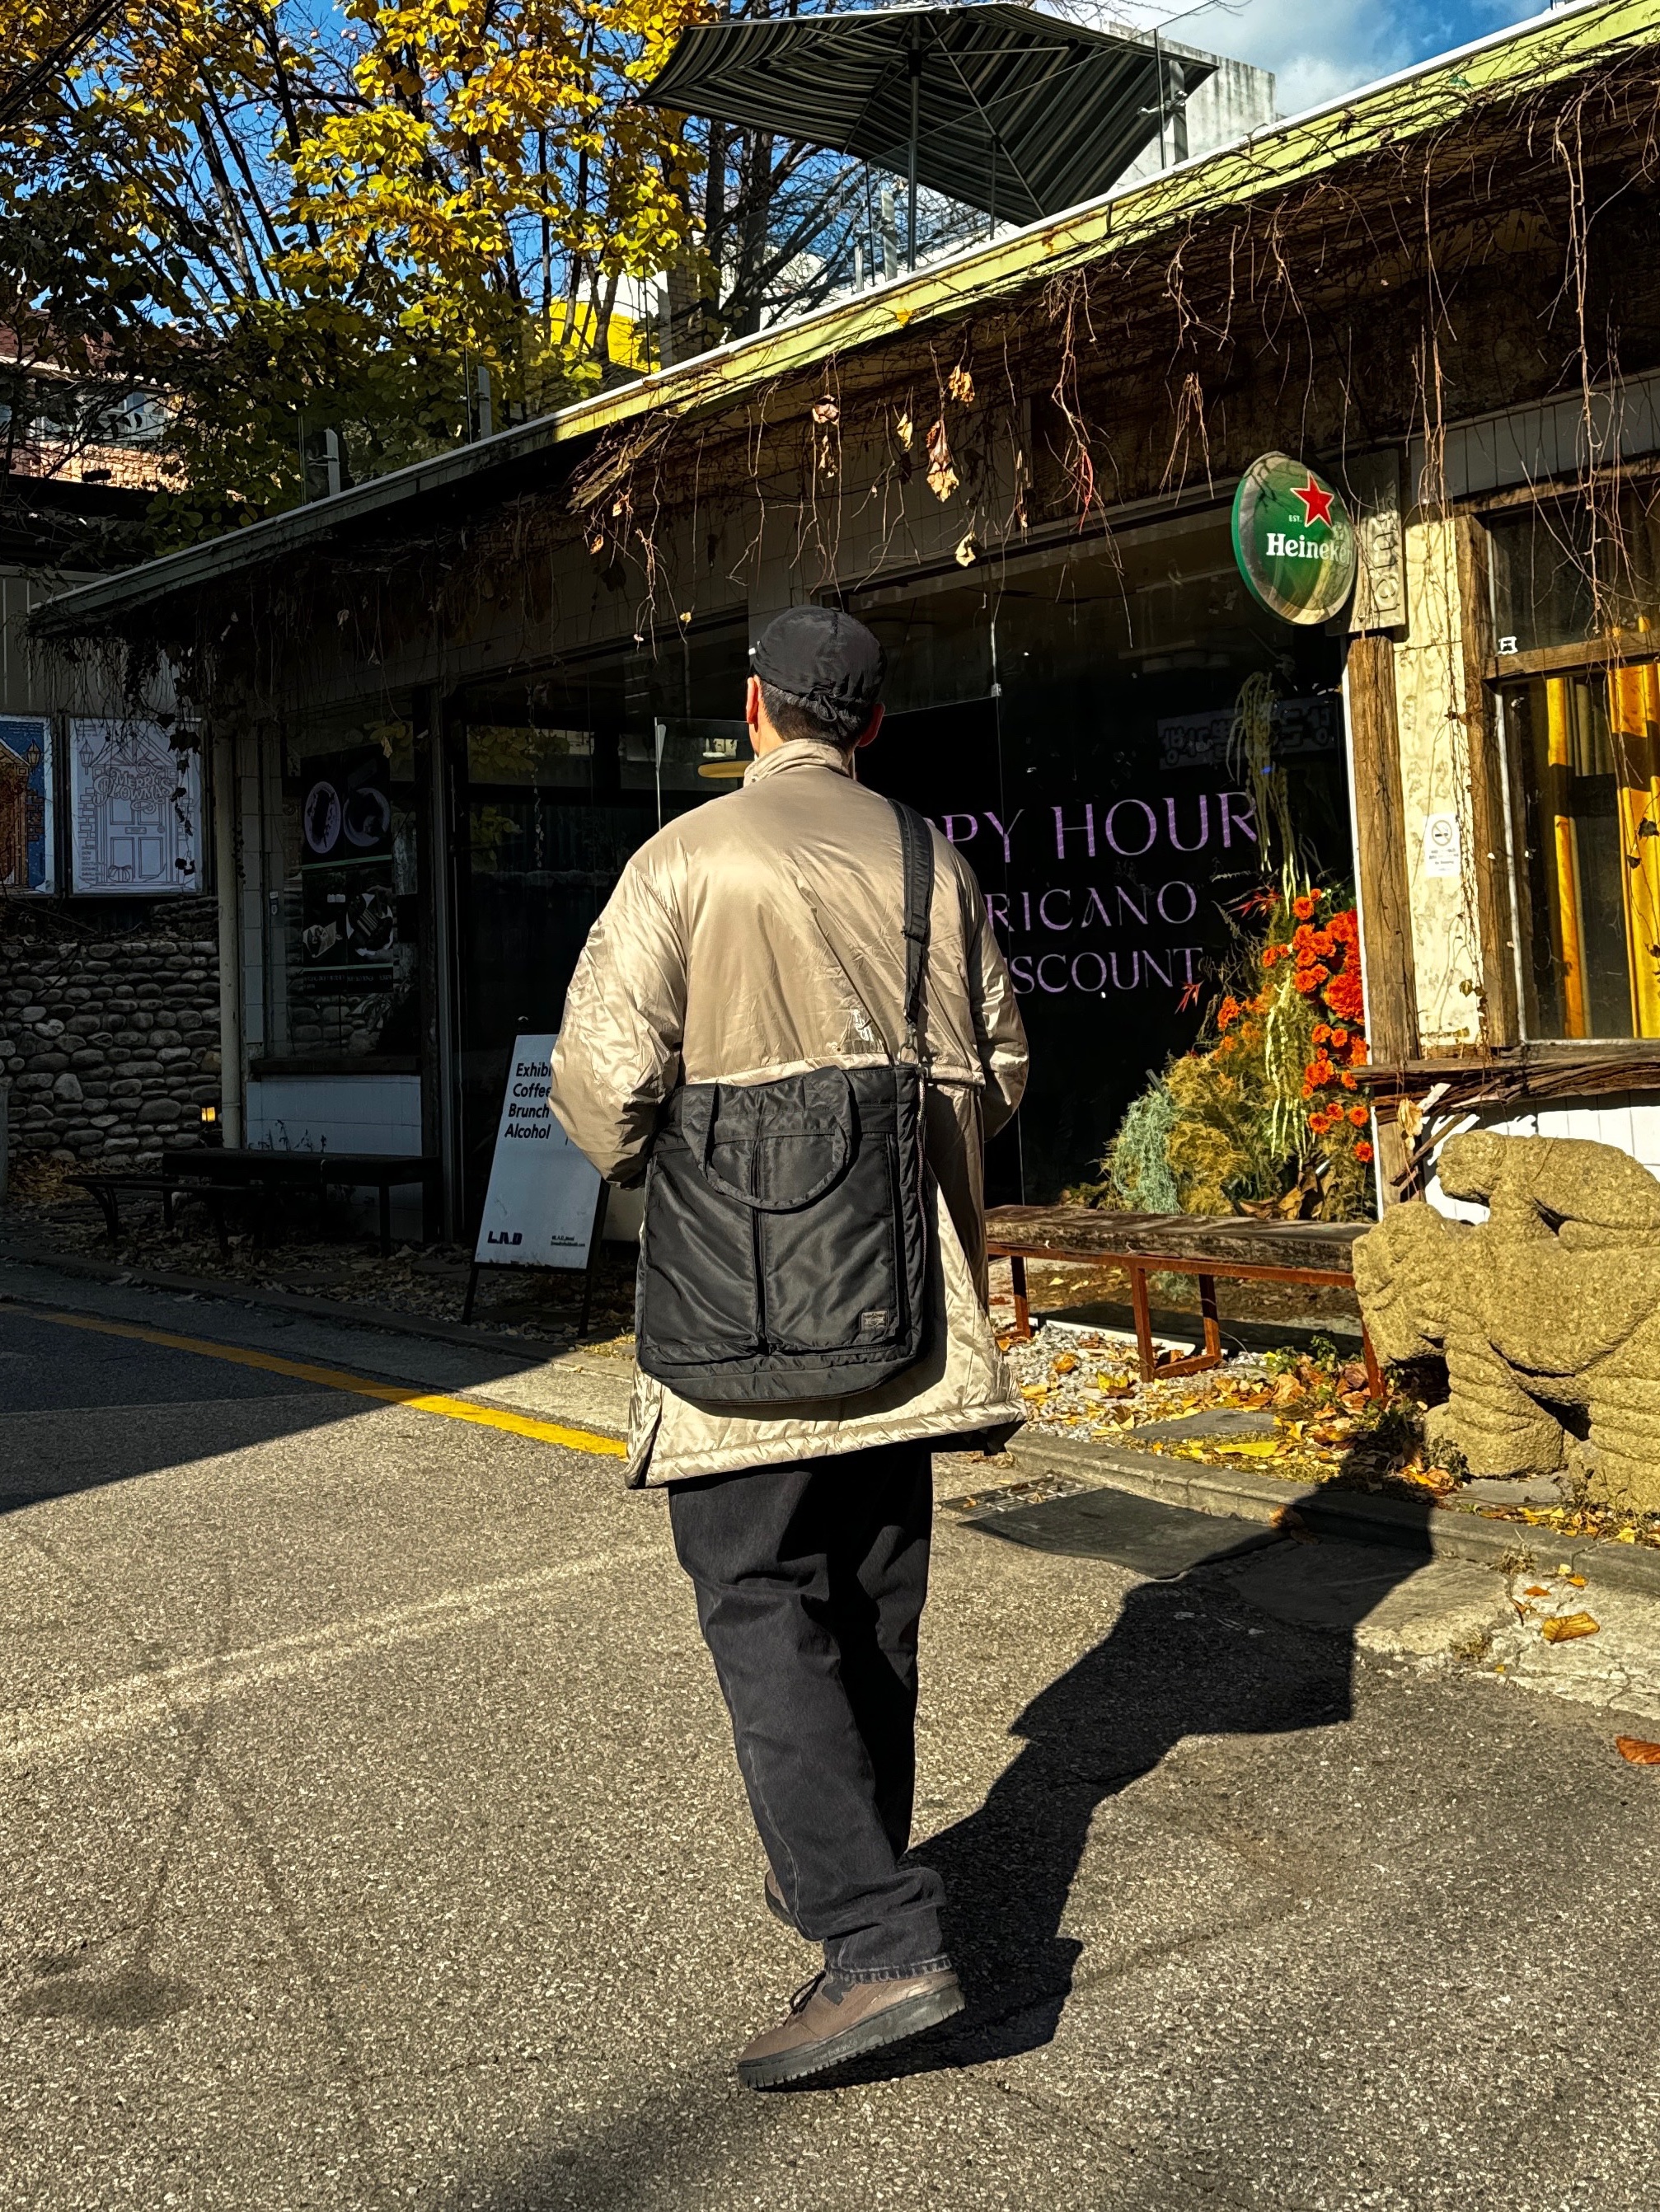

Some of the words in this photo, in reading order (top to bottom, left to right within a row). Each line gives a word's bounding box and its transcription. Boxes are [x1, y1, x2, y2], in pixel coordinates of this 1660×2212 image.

[1288, 514, 1302, 523] EST.
[1266, 532, 1353, 565] Heineken
[112, 761, 165, 789] MERRY
[923, 808, 1025, 864] PY
[1050, 791, 1258, 860] HOUR
[1003, 947, 1203, 995] SCOUNT
[513, 1082, 551, 1099] Coffee
[508, 1103, 550, 1118] Brunch
[504, 1122, 551, 1140] Alcohol
